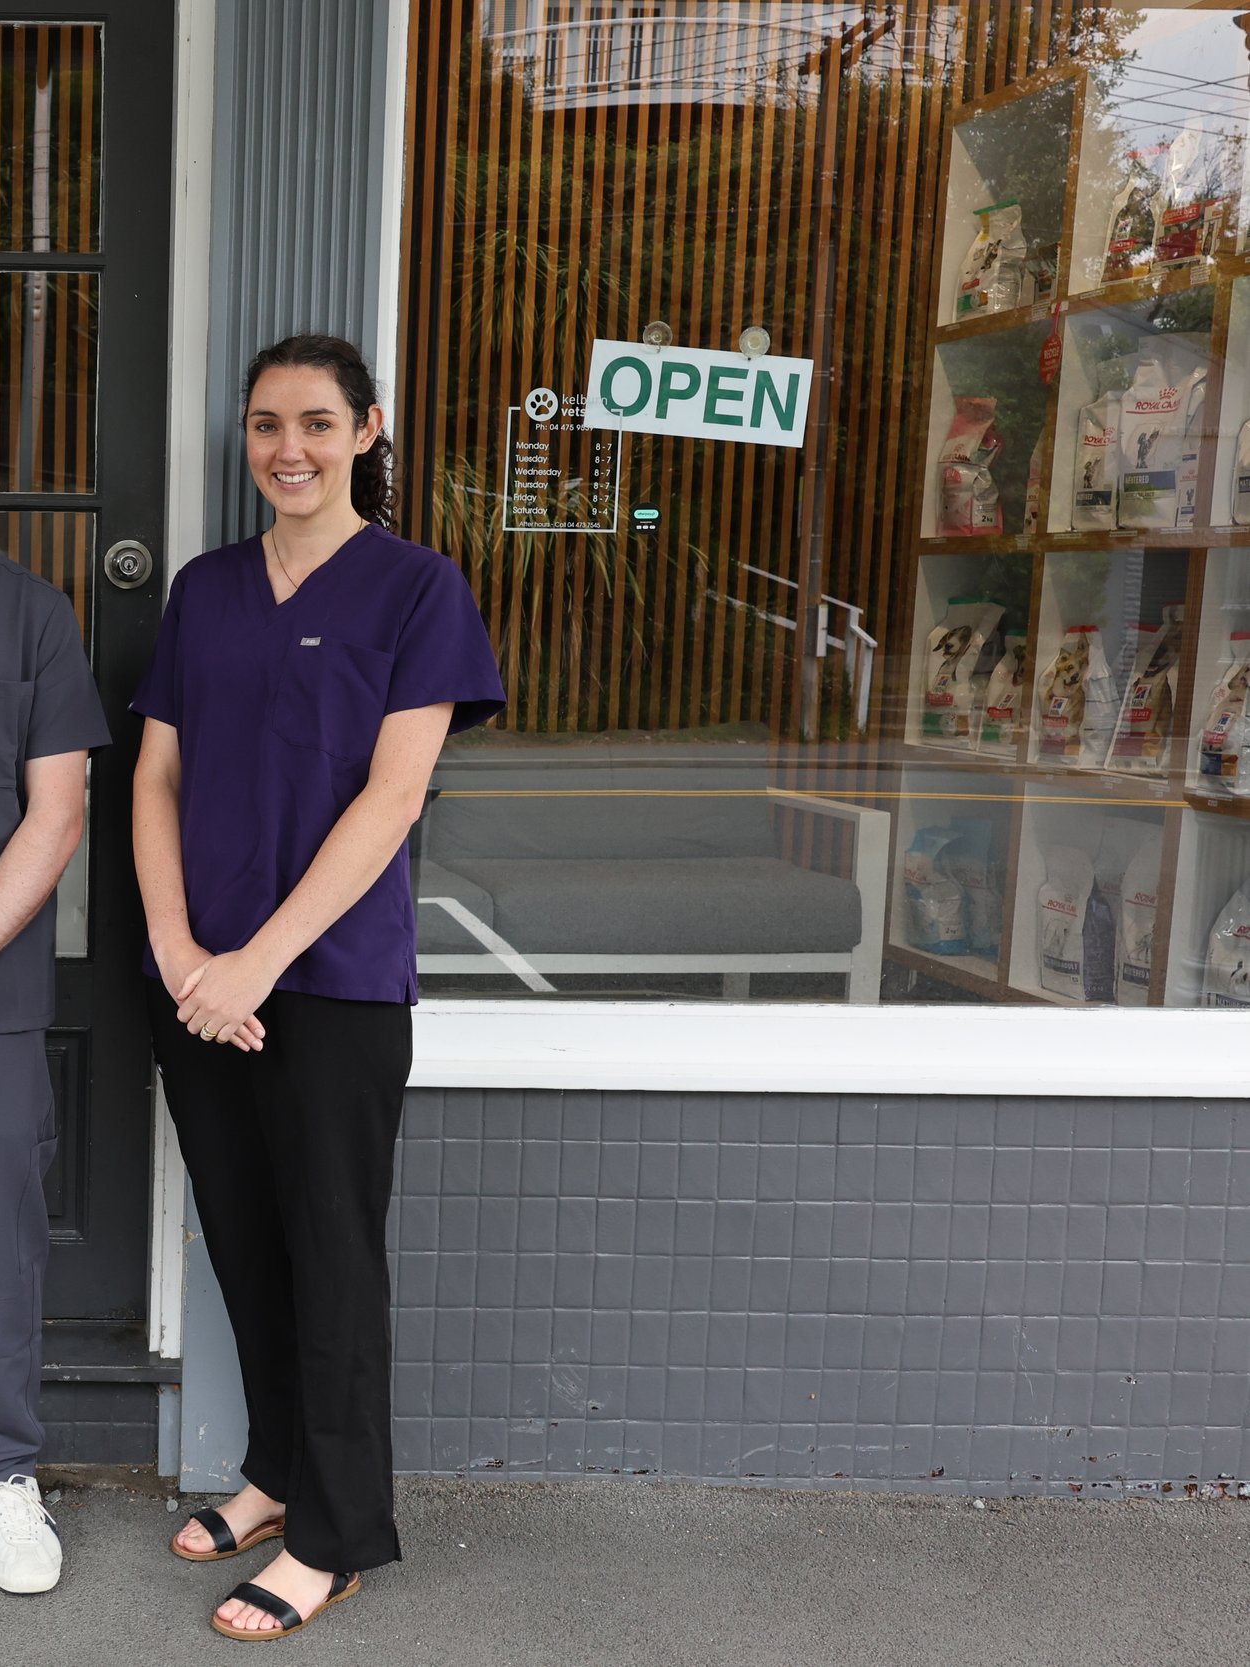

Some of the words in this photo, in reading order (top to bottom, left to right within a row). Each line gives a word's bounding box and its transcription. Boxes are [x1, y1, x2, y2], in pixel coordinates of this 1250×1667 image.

[600, 356, 800, 432] OPEN
[1135, 401, 1160, 410] ROYAL
[561, 406, 587, 416] vets
[516, 442, 549, 451] Monday
[515, 455, 547, 464] Tuesday
[515, 467, 561, 477] Wednesday
[514, 481, 548, 490] Thursday
[514, 494, 537, 502] Friday
[513, 507, 548, 515] Saturday
